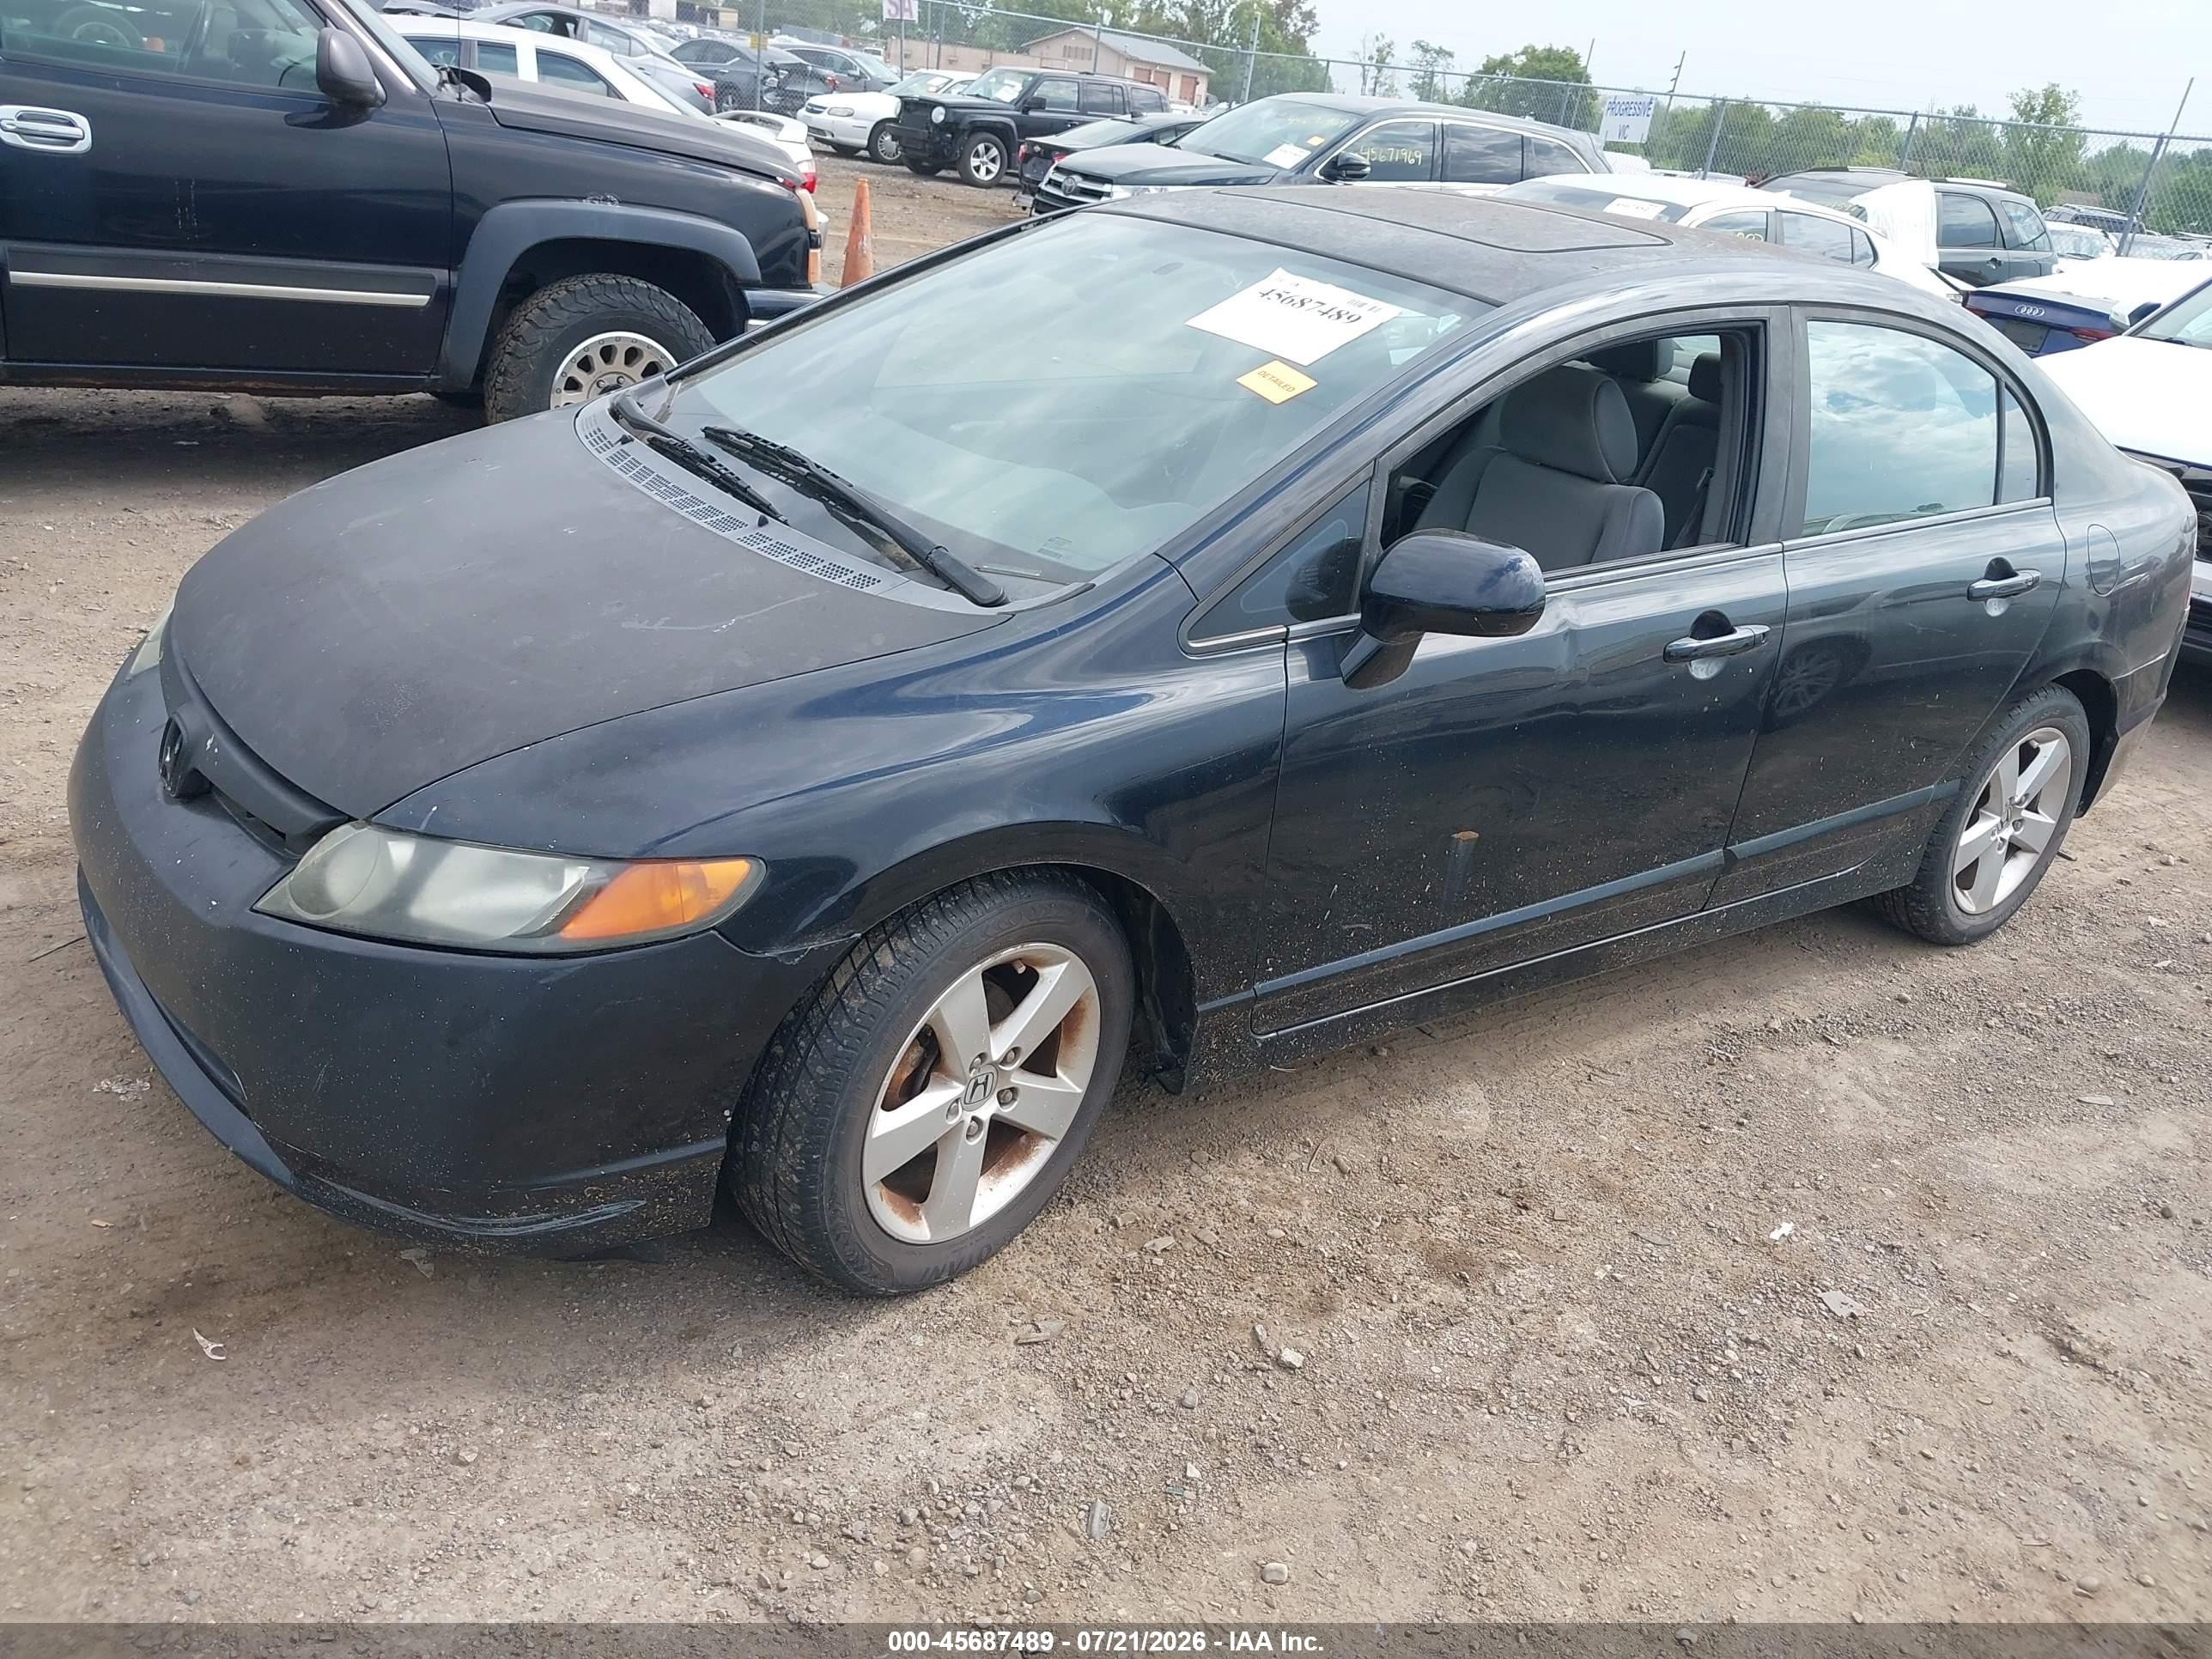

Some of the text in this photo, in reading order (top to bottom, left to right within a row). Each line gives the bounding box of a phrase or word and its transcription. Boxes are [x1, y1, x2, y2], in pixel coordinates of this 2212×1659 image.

[1607, 100, 1653, 118] PROGRESSIVE
[1359, 145, 1423, 166] 45671969
[1258, 288, 1363, 324] 45687489
[1257, 370, 1296, 392] DETAILED
